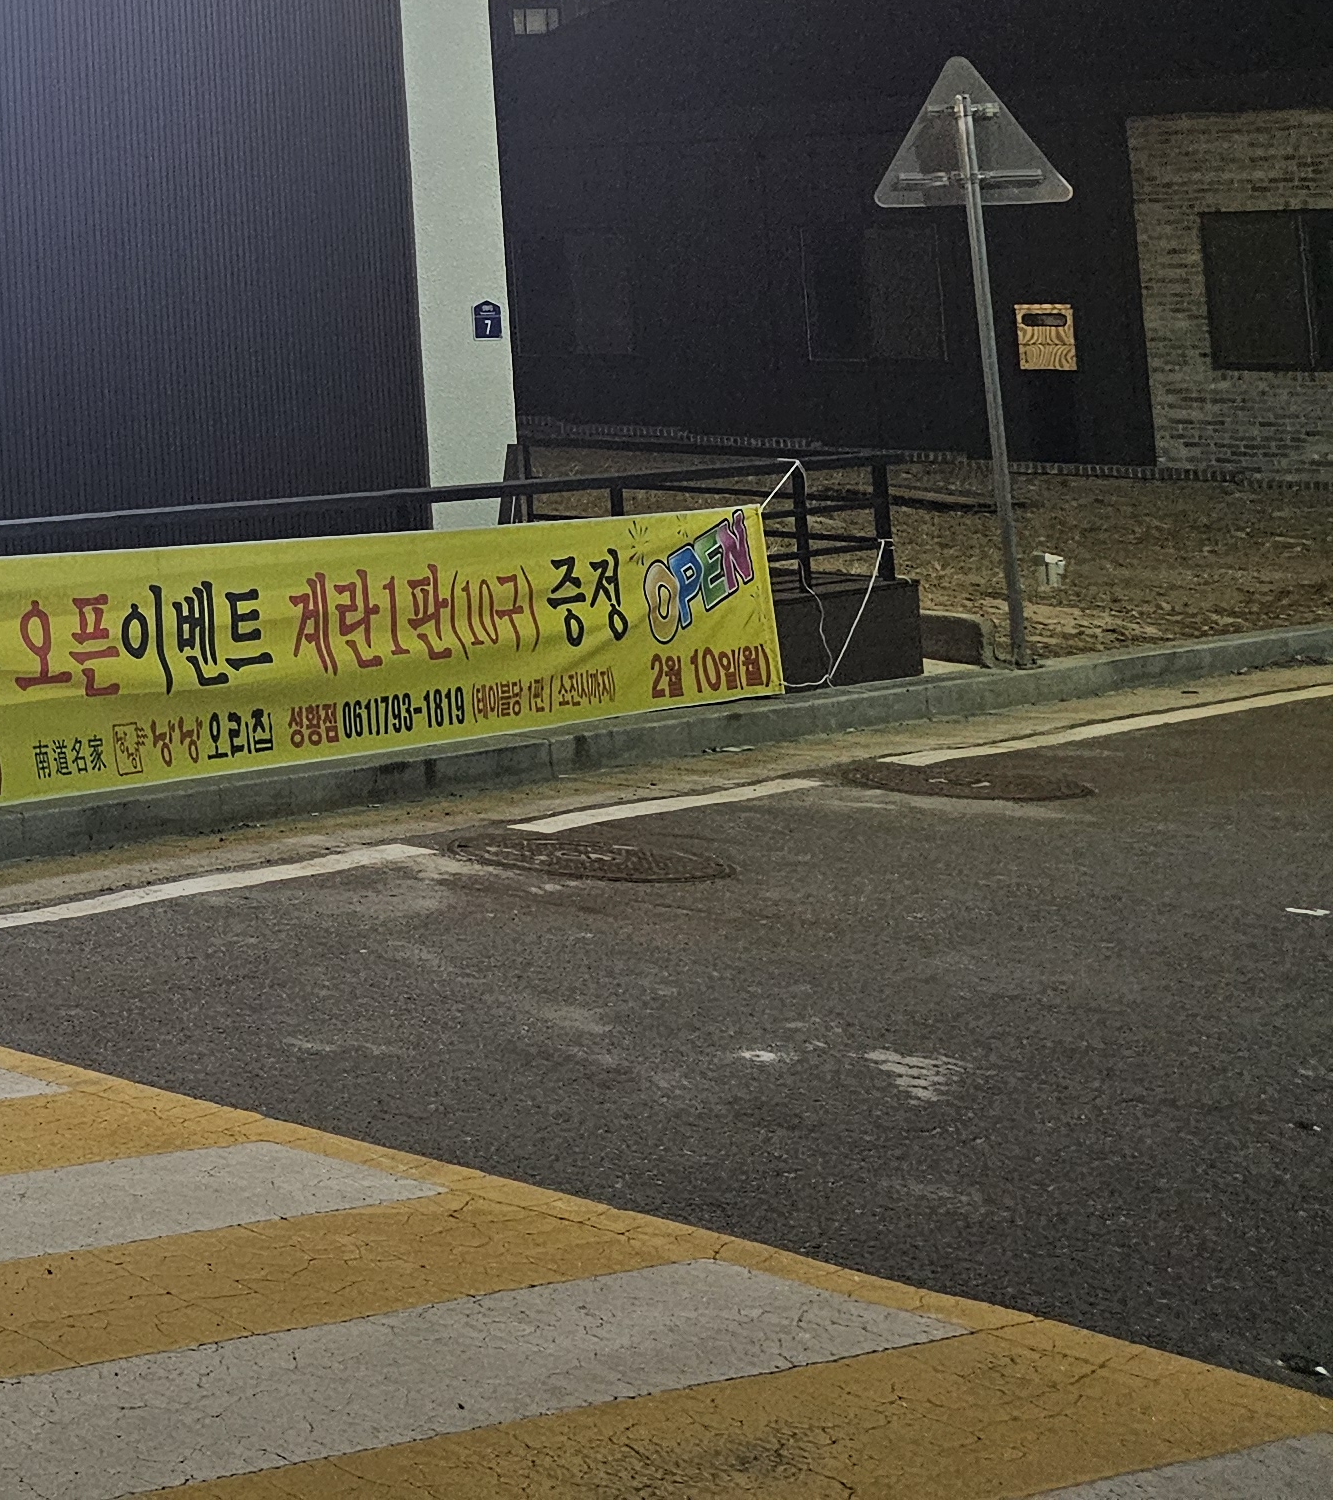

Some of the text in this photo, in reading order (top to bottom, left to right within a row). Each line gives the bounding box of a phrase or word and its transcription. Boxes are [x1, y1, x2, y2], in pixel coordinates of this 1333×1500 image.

[485, 320, 491, 335] 7
[643, 509, 754, 645] OPEN
[15, 581, 273, 698] 오픈이벤트
[547, 548, 630, 647] 증정
[651, 643, 771, 699] 2월 10일(월)
[208, 708, 273, 760] 오리집
[288, 702, 339, 748] 성황점
[342, 686, 465, 739] 061)793-1819
[33, 735, 107, 779] 南道名家
